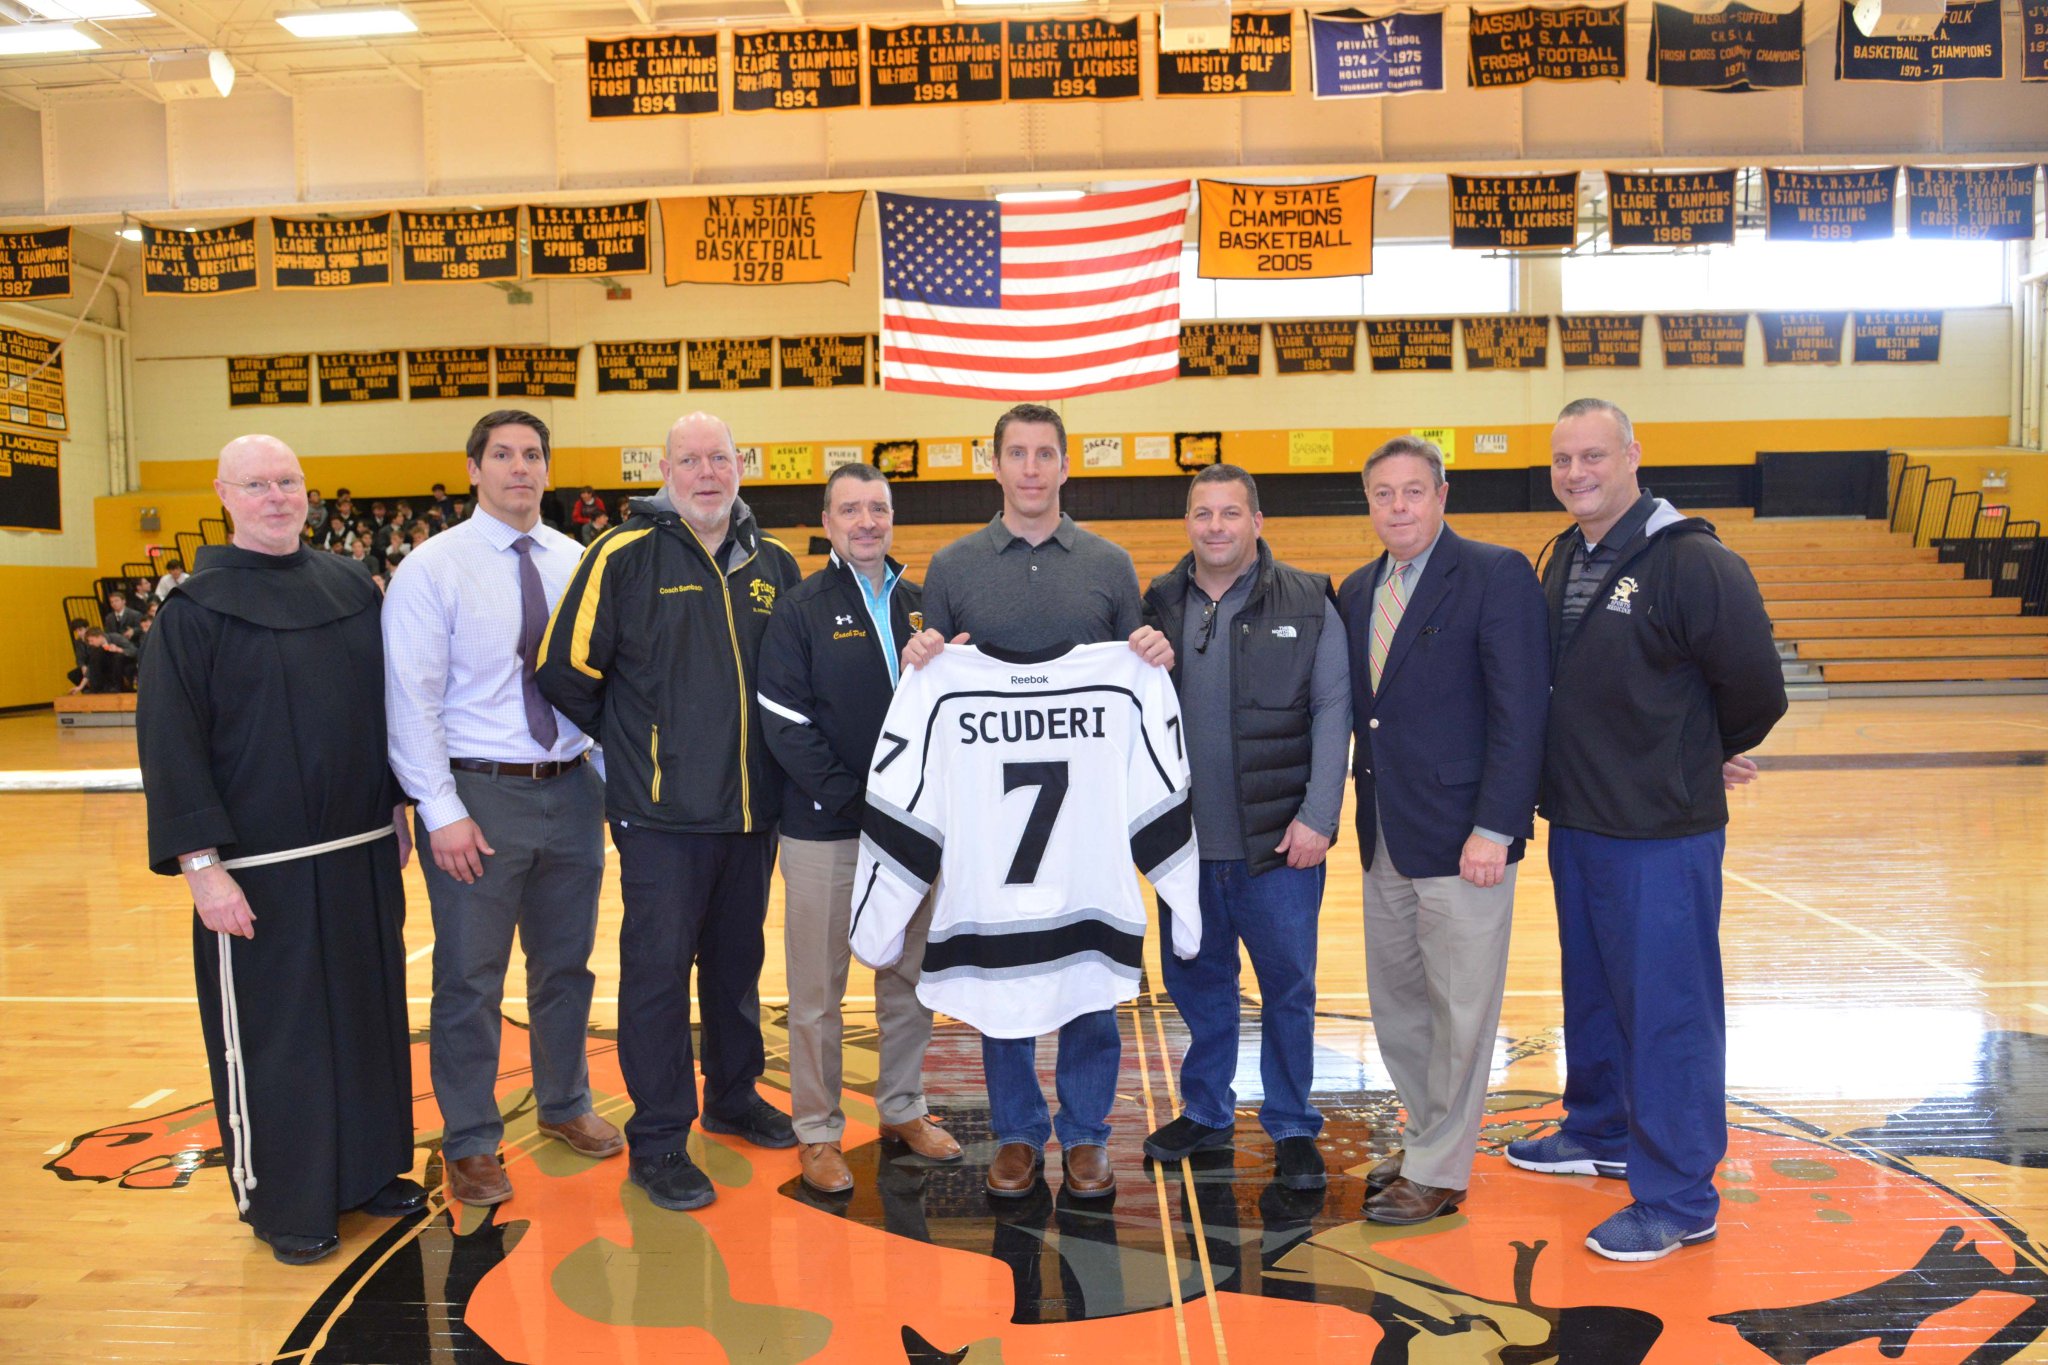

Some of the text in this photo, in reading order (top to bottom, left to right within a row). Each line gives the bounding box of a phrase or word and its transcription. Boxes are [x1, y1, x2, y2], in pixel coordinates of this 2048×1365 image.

[1010, 39, 1137, 60] LEAGUE CHAMPIONS
[1337, 35, 1421, 50] PRIVATE SCHOOL
[870, 44, 1000, 66] LEAGUE CHAMPIONS
[1339, 50, 1422, 67] 1974 1975
[1480, 48, 1617, 71] FROSH FOOTBALL
[1854, 44, 1992, 60] BASKETBALL CHAMPIONS
[590, 56, 716, 78] LEAGUE CHAMPIONS
[735, 50, 858, 73] LEAGUE CHAMPIONS
[1010, 57, 1137, 79] VARSITY LACROSSE
[1176, 55, 1274, 74] VARSITY GOLF
[1725, 62, 1746, 77] 1971
[1339, 66, 1421, 79] HOLIDAY HOCKEY
[1482, 63, 1619, 85] CHAMPIONS 1969
[591, 75, 717, 97] FROSH BASKETBALL
[1053, 79, 1097, 97] 1994
[1203, 73, 1248, 92] 1994
[775, 89, 818, 107] 1994
[914, 83, 958, 101] 1994
[632, 95, 676, 113] 1994
[1275, 186, 1340, 205] STATE
[1774, 189, 1888, 205] STATE CHAMPIONS
[1910, 182, 2032, 198] LEAGUE CHAMPIONS
[753, 196, 813, 216] STATE
[1454, 193, 1574, 211] LEAGUE CHAMPIONS
[1614, 191, 1730, 209] LEAGUE CHAMPIONS
[1229, 207, 1342, 227] CHAMPIONS
[1514, 211, 1573, 228] LACROSSE
[1681, 208, 1724, 224] SOCCER
[1798, 207, 1866, 223] WRESTLING
[1920, 210, 2021, 226] CROSS COUNTRY
[404, 227, 514, 246] LEAGUE CHAMPIONS
[531, 220, 645, 240] LEAGUE CHAMPIONS
[704, 217, 815, 238] CHAMPIONS
[1653, 227, 1692, 242] 1986
[1812, 225, 1852, 239] 1989
[276, 233, 388, 253] LEAGUE CHAMPIONS
[1219, 229, 1352, 249] BASKETBALL
[1500, 230, 1528, 244] 1986
[18, 246, 68, 264] CHAMPIONS
[144, 240, 254, 260] LEAGUE CHAMPIONS
[414, 244, 506, 262] VARSITY SOCCER
[544, 239, 633, 257] SPRING TRACK
[696, 239, 822, 261] BASKETBALL
[198, 256, 254, 275] WRESTLING
[329, 250, 388, 268] SPRING TRACK
[569, 257, 607, 273] 1986
[1258, 253, 1312, 271] 2005
[22, 262, 68, 279] FOOTBALL
[313, 270, 350, 285] 1988
[442, 263, 479, 279] 1986
[733, 262, 784, 282] 1978
[0, 281, 32, 295] 1987
[183, 277, 219, 292] 1988
[1085, 439, 1119, 453] JACKIE
[623, 451, 652, 464] ERIN
[622, 470, 642, 481] #4
[833, 629, 866, 639] Coach Pat
[1010, 674, 1049, 685] Reebok
[959, 706, 1106, 745] SCUDERI
[872, 731, 910, 775] 7
[1000, 758, 1070, 888] 7
